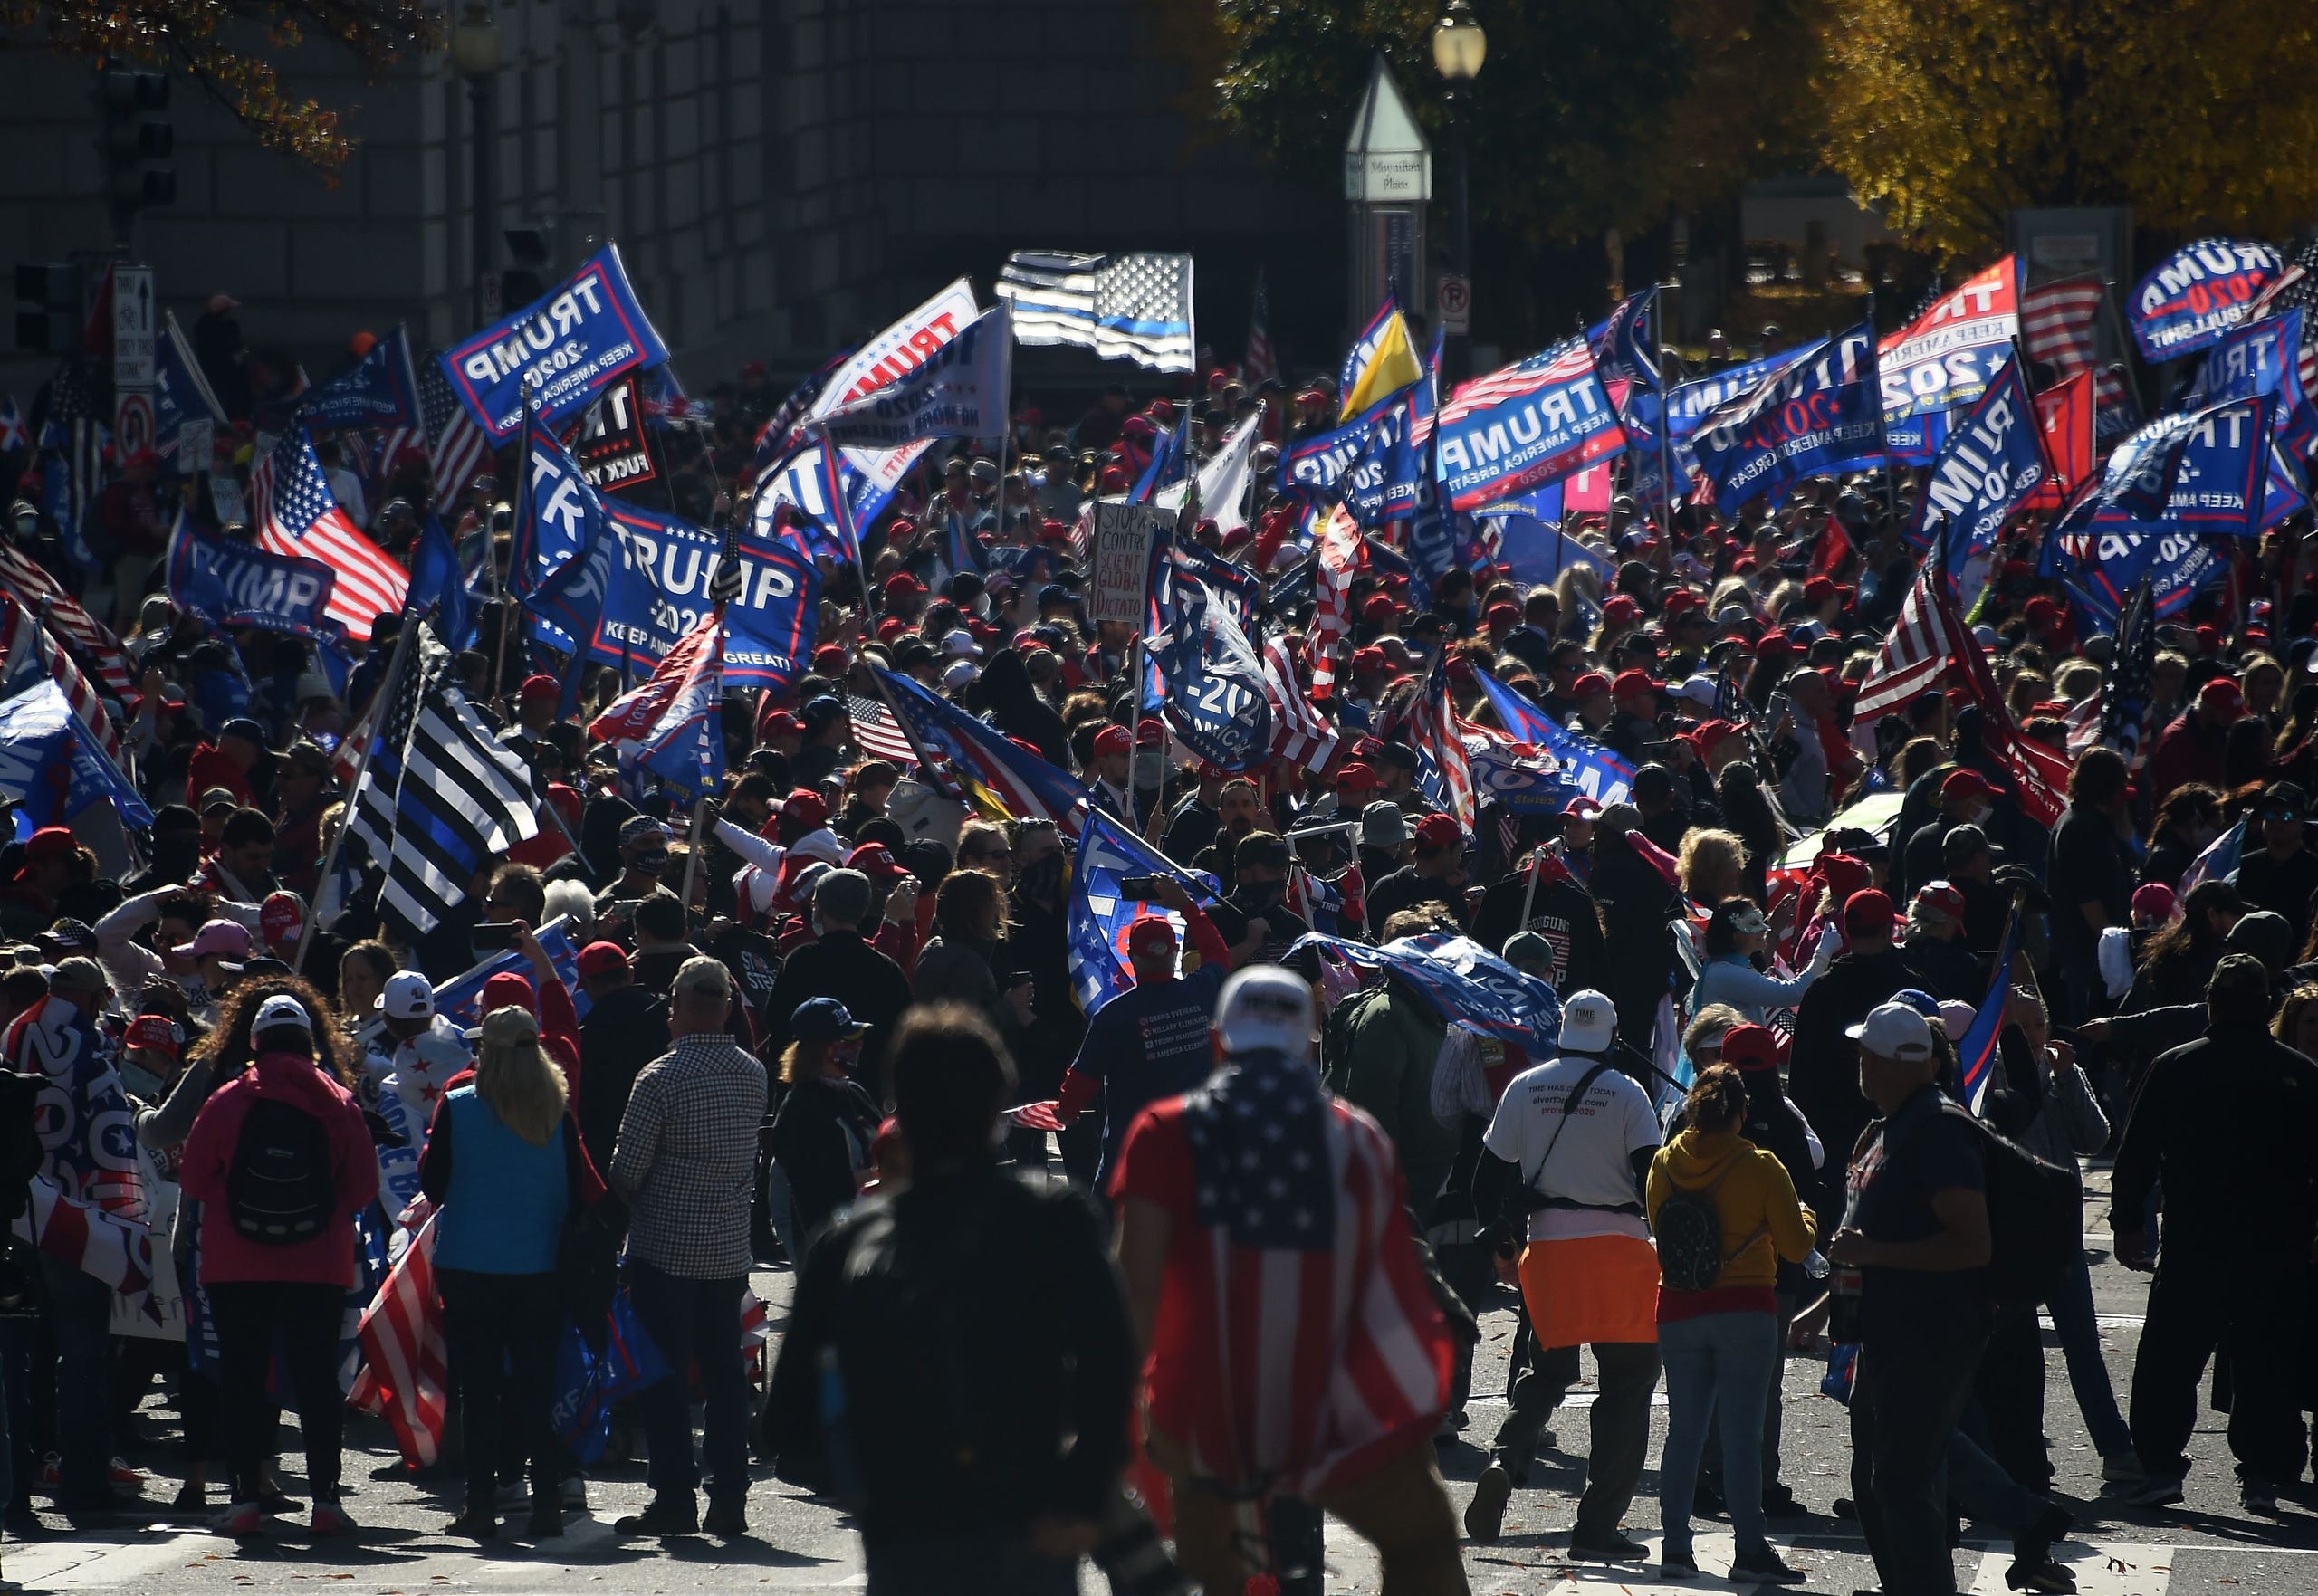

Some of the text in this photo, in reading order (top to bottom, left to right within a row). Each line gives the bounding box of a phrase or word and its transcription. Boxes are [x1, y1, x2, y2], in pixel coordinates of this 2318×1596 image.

[1371, 158, 1422, 174] Moynihan
[1383, 177, 1409, 190] Place
[116, 339, 154, 357] OBEY THIS
[1103, 505, 1138, 531] STOP
[1098, 569, 1140, 593] GLOBA
[1096, 588, 1141, 616] DICTATO
[605, 619, 649, 647] KEEP
[723, 652, 790, 672] GREAT!
[1514, 794, 1556, 806] States
[264, 914, 292, 925] TRUMP
[1149, 1012, 1171, 1024] OBAMA
[1576, 1008, 1595, 1019] TIME
[1152, 1023, 1177, 1035] HILLARY
[1154, 1036, 1175, 1046] TRUMP
[1156, 1046, 1184, 1057] AMERICA
[1528, 1085, 1546, 1094] TIME
[1547, 1085, 1565, 1093] HAS
[1589, 1087, 1616, 1098] TODAY
